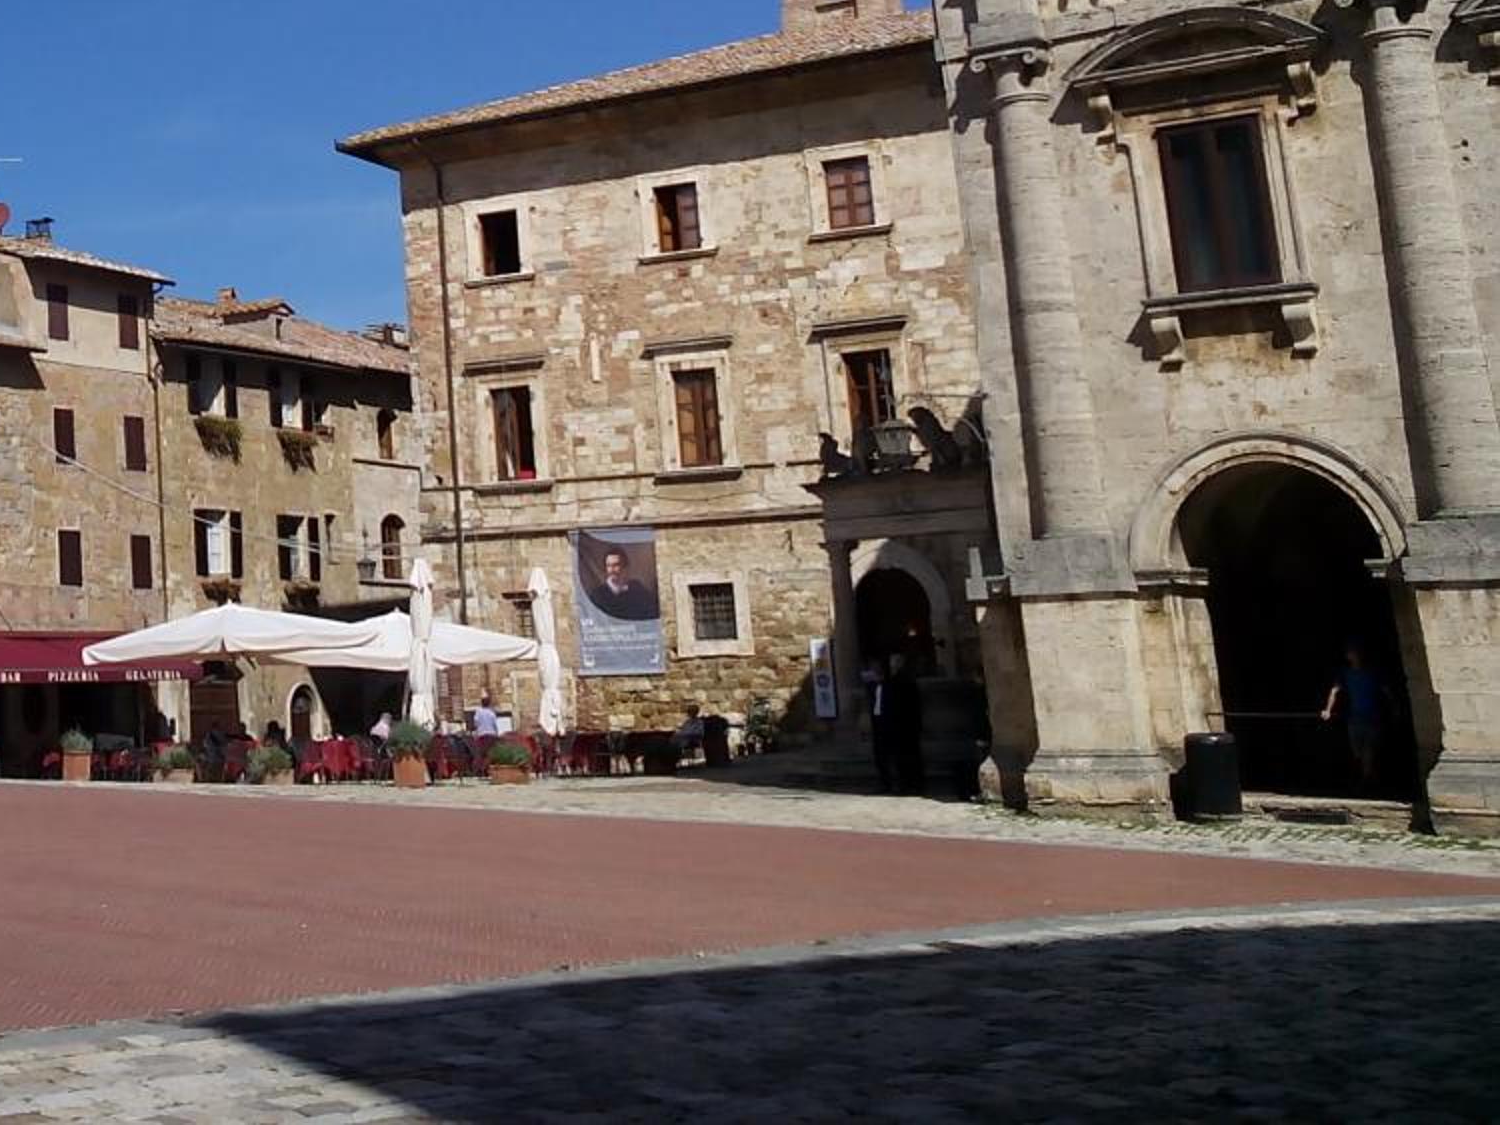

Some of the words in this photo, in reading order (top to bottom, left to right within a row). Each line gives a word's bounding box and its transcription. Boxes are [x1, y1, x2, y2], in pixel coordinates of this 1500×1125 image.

[0, 671, 20, 683] BAR
[47, 670, 99, 682] PIZZERIA
[125, 670, 181, 681] GELATERIA
